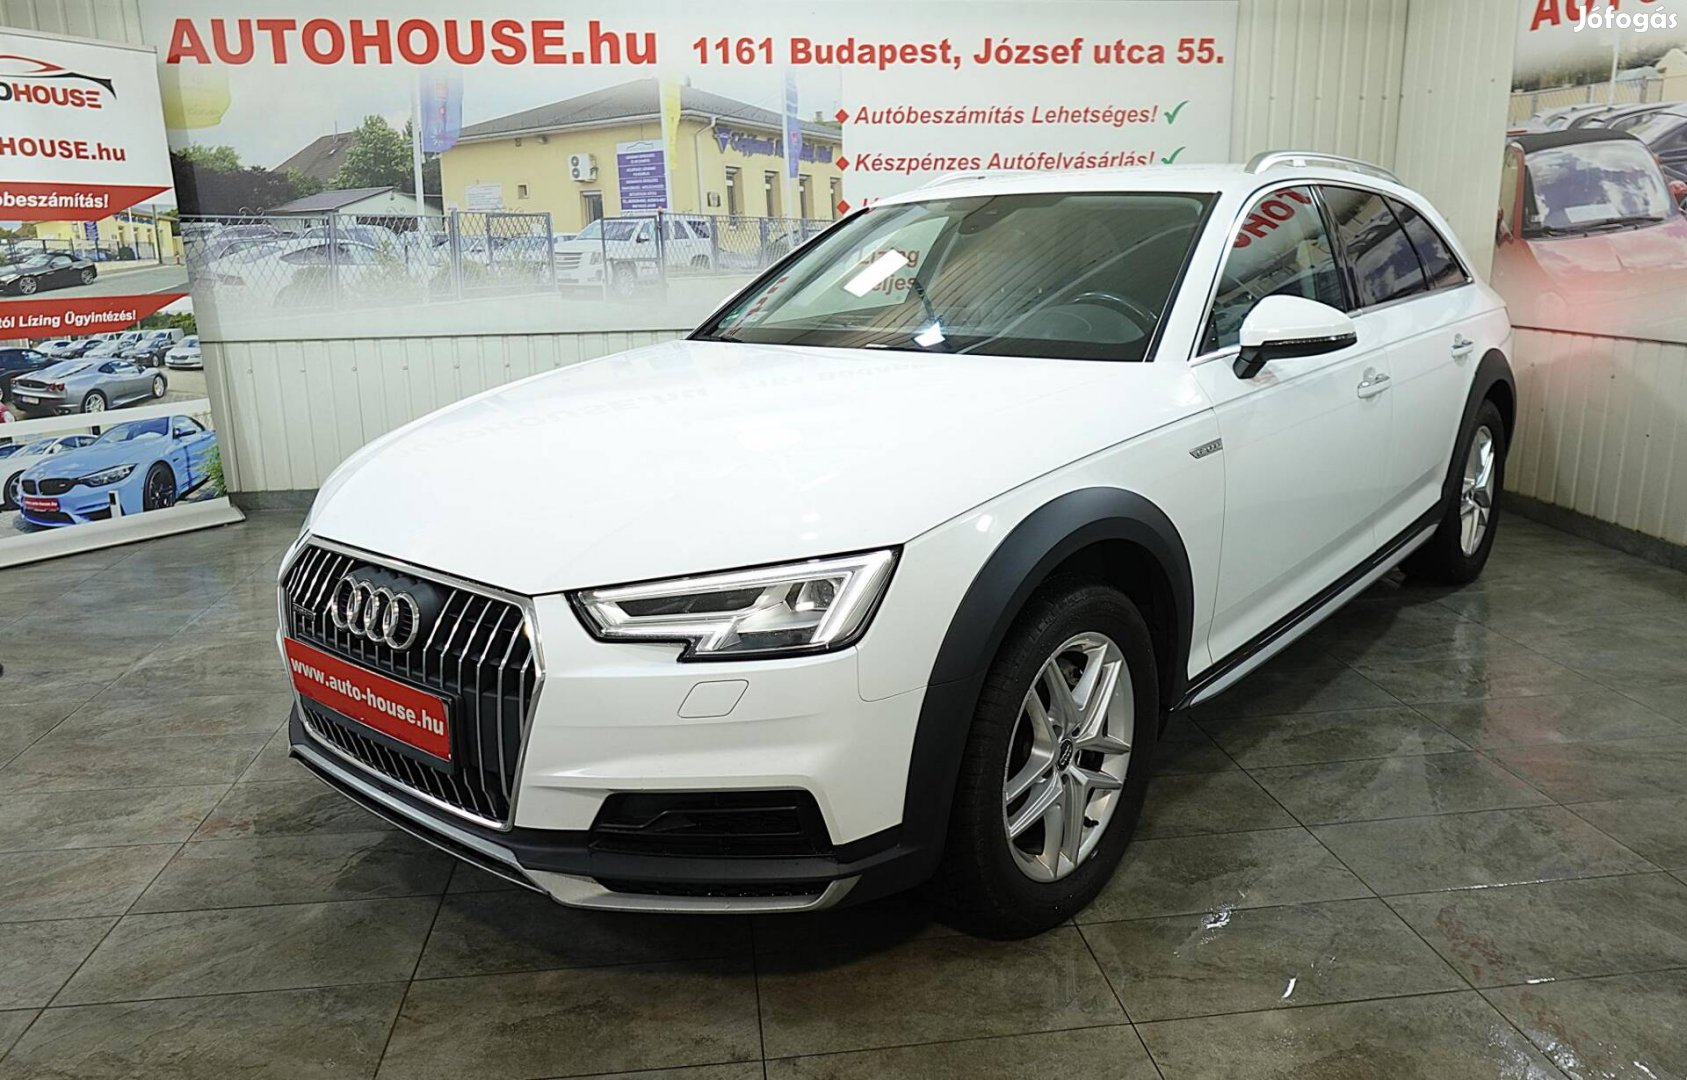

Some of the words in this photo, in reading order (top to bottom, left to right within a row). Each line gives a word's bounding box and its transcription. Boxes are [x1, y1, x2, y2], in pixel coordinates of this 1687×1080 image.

[166, 16, 657, 66] AUTOHOUSE.hu
[692, 36, 774, 65] 1161
[790, 36, 962, 71] Budapest,
[973, 35, 1085, 66] József
[1093, 38, 1166, 66] utca
[1176, 36, 1225, 65] 55.
[854, 104, 1024, 126] Autóbeszámítás
[1031, 105, 1158, 128] Lehetséges!
[854, 147, 981, 173] Készpénzes
[986, 149, 1155, 171] Autófelvásárlás!
[0, 191, 109, 209] beszámítás!
[19, 314, 61, 328] Lízing
[290, 657, 444, 736] www.auto-house.hu
